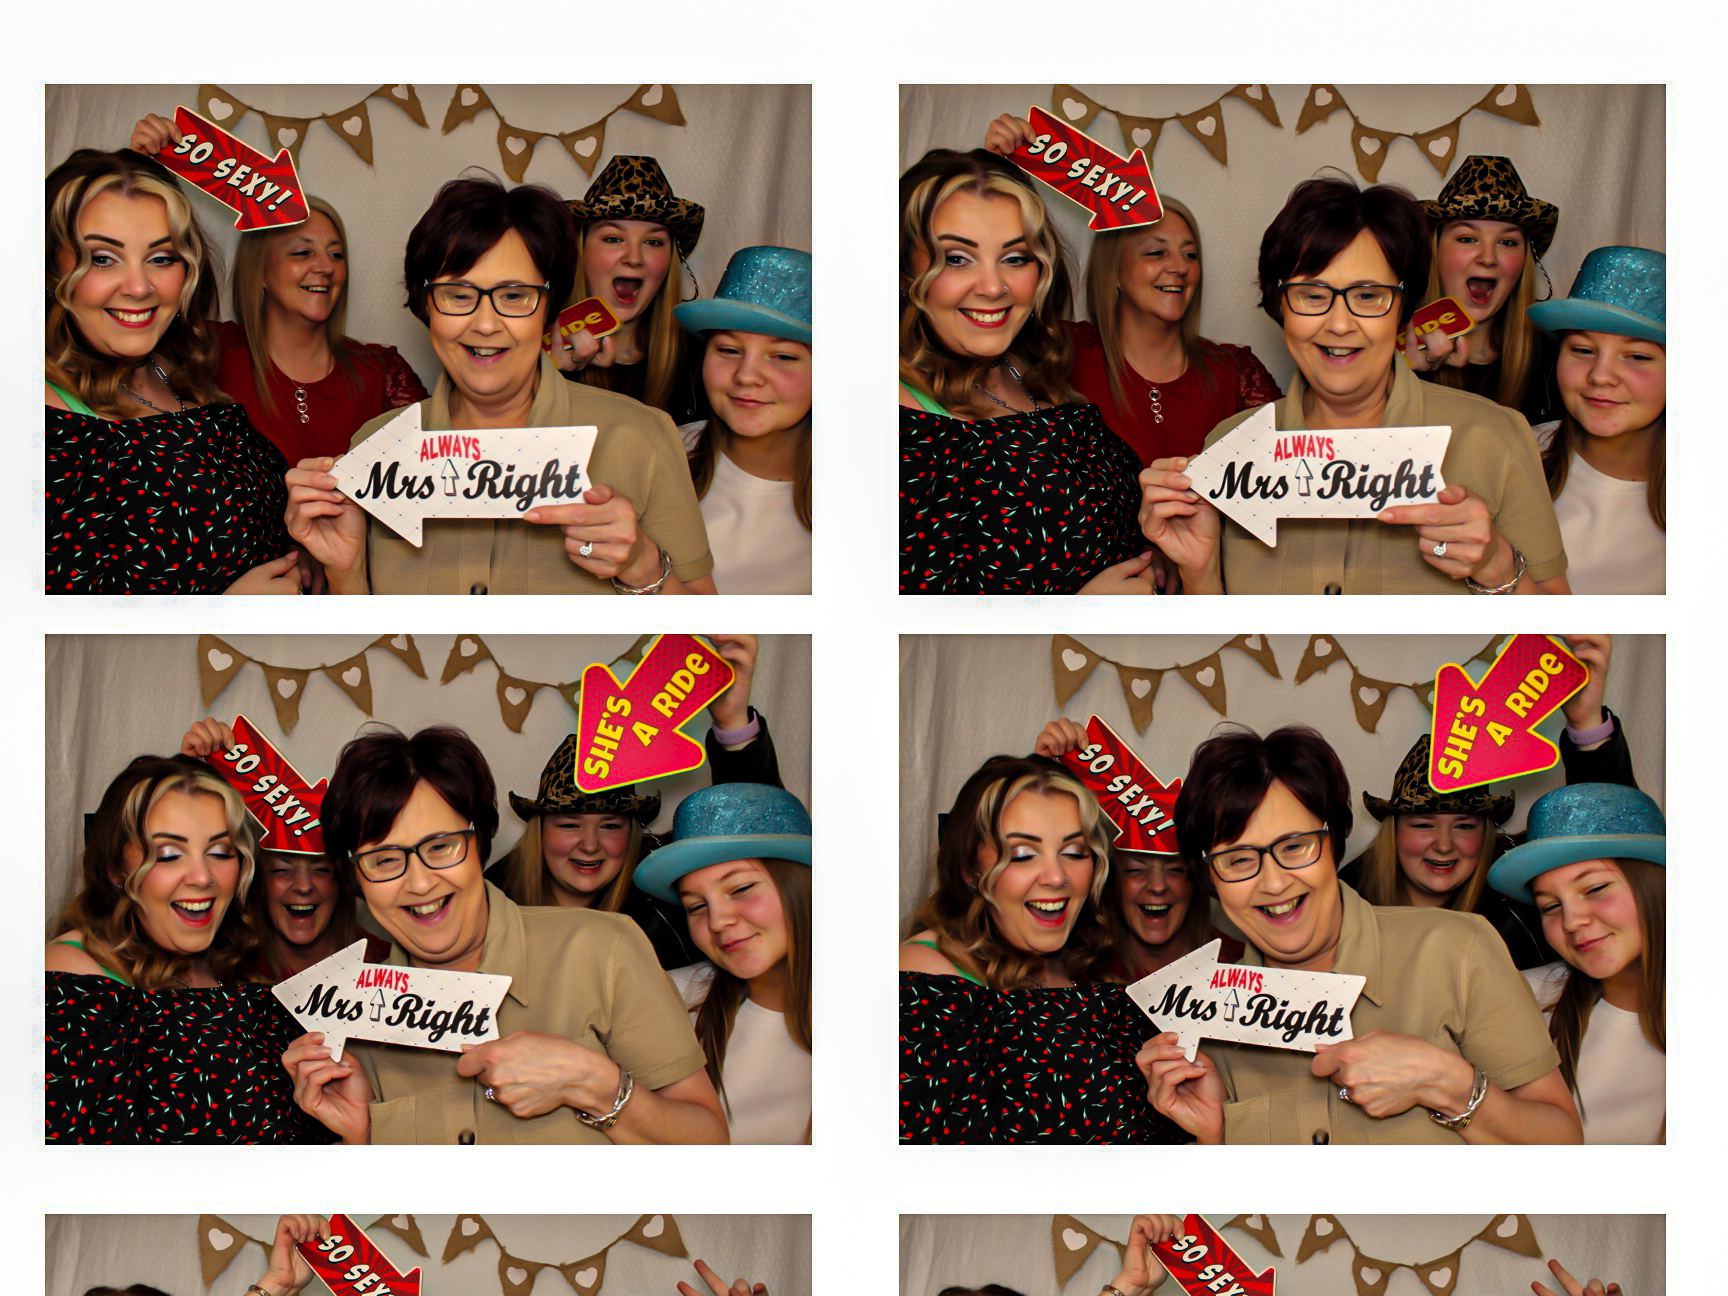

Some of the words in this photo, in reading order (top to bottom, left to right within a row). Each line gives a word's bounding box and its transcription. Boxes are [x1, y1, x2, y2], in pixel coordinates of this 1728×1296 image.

[174, 134, 214, 164] SO
[213, 158, 293, 212] SEXY!
[1028, 134, 1068, 164] SO
[1067, 158, 1147, 212] SEXY!
[420, 435, 481, 462] ALWAYS
[1274, 435, 1335, 462] ALWAYS
[355, 461, 435, 500] Mrs
[463, 458, 582, 512] Right
[1209, 461, 1289, 500] Mrs
[1317, 458, 1436, 512] Right
[583, 695, 632, 779] SHE'S
[631, 720, 660, 747] A
[1437, 695, 1486, 779] SHE'S
[1485, 720, 1514, 747] A
[224, 744, 260, 774] SO
[252, 775, 321, 837] SEXY!
[1078, 744, 1114, 774] SO
[1106, 775, 1175, 837] SEXY!
[356, 968, 409, 993] ALWAYS
[1210, 968, 1263, 993] ALWAYS
[294, 984, 363, 1021] Mrs
[385, 993, 490, 1043] Right
[1148, 984, 1217, 1021] Mrs
[1239, 993, 1344, 1043] Right
[317, 1235, 354, 1264] SO
[1171, 1235, 1208, 1264] SO
